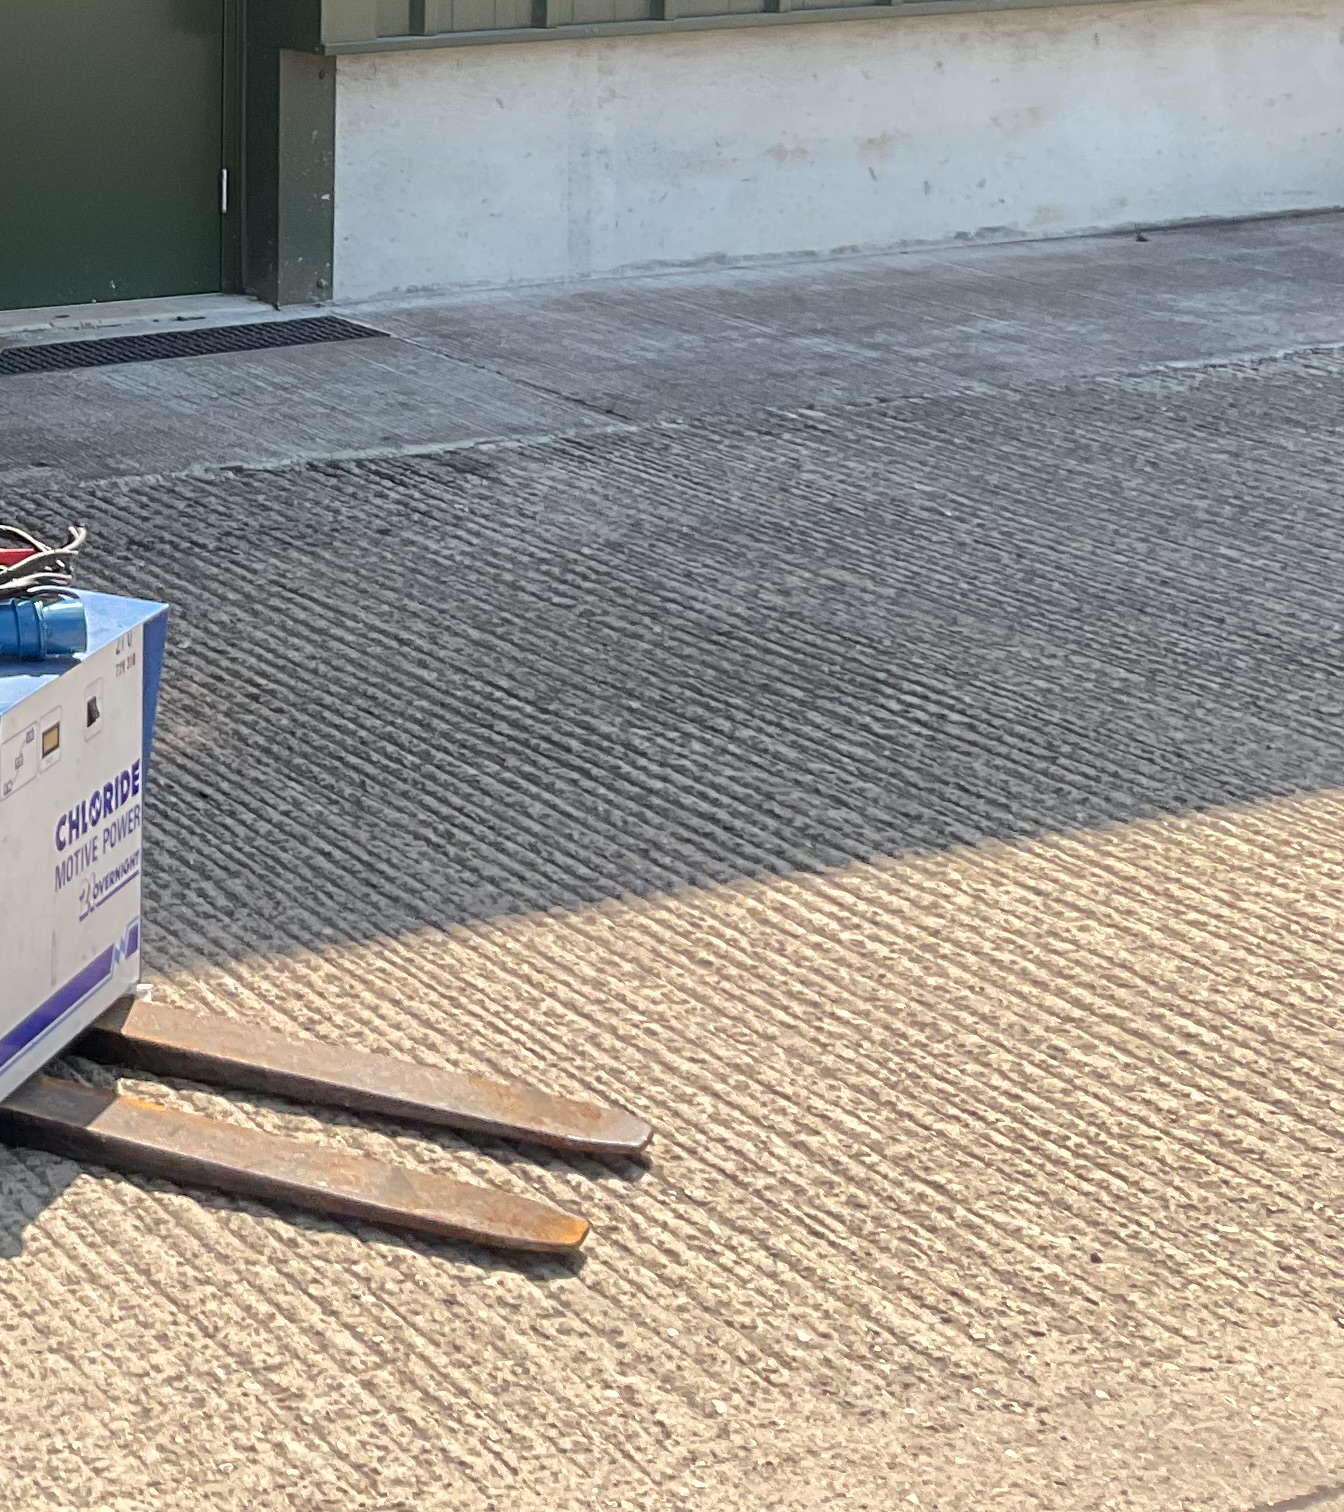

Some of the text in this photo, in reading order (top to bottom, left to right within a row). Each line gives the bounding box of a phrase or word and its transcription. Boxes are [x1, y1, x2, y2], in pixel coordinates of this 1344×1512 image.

[54, 803, 141, 893] MOTIVE POWER
[55, 758, 140, 852] CHLORIDE
[92, 849, 140, 900] OVERNIGHT
